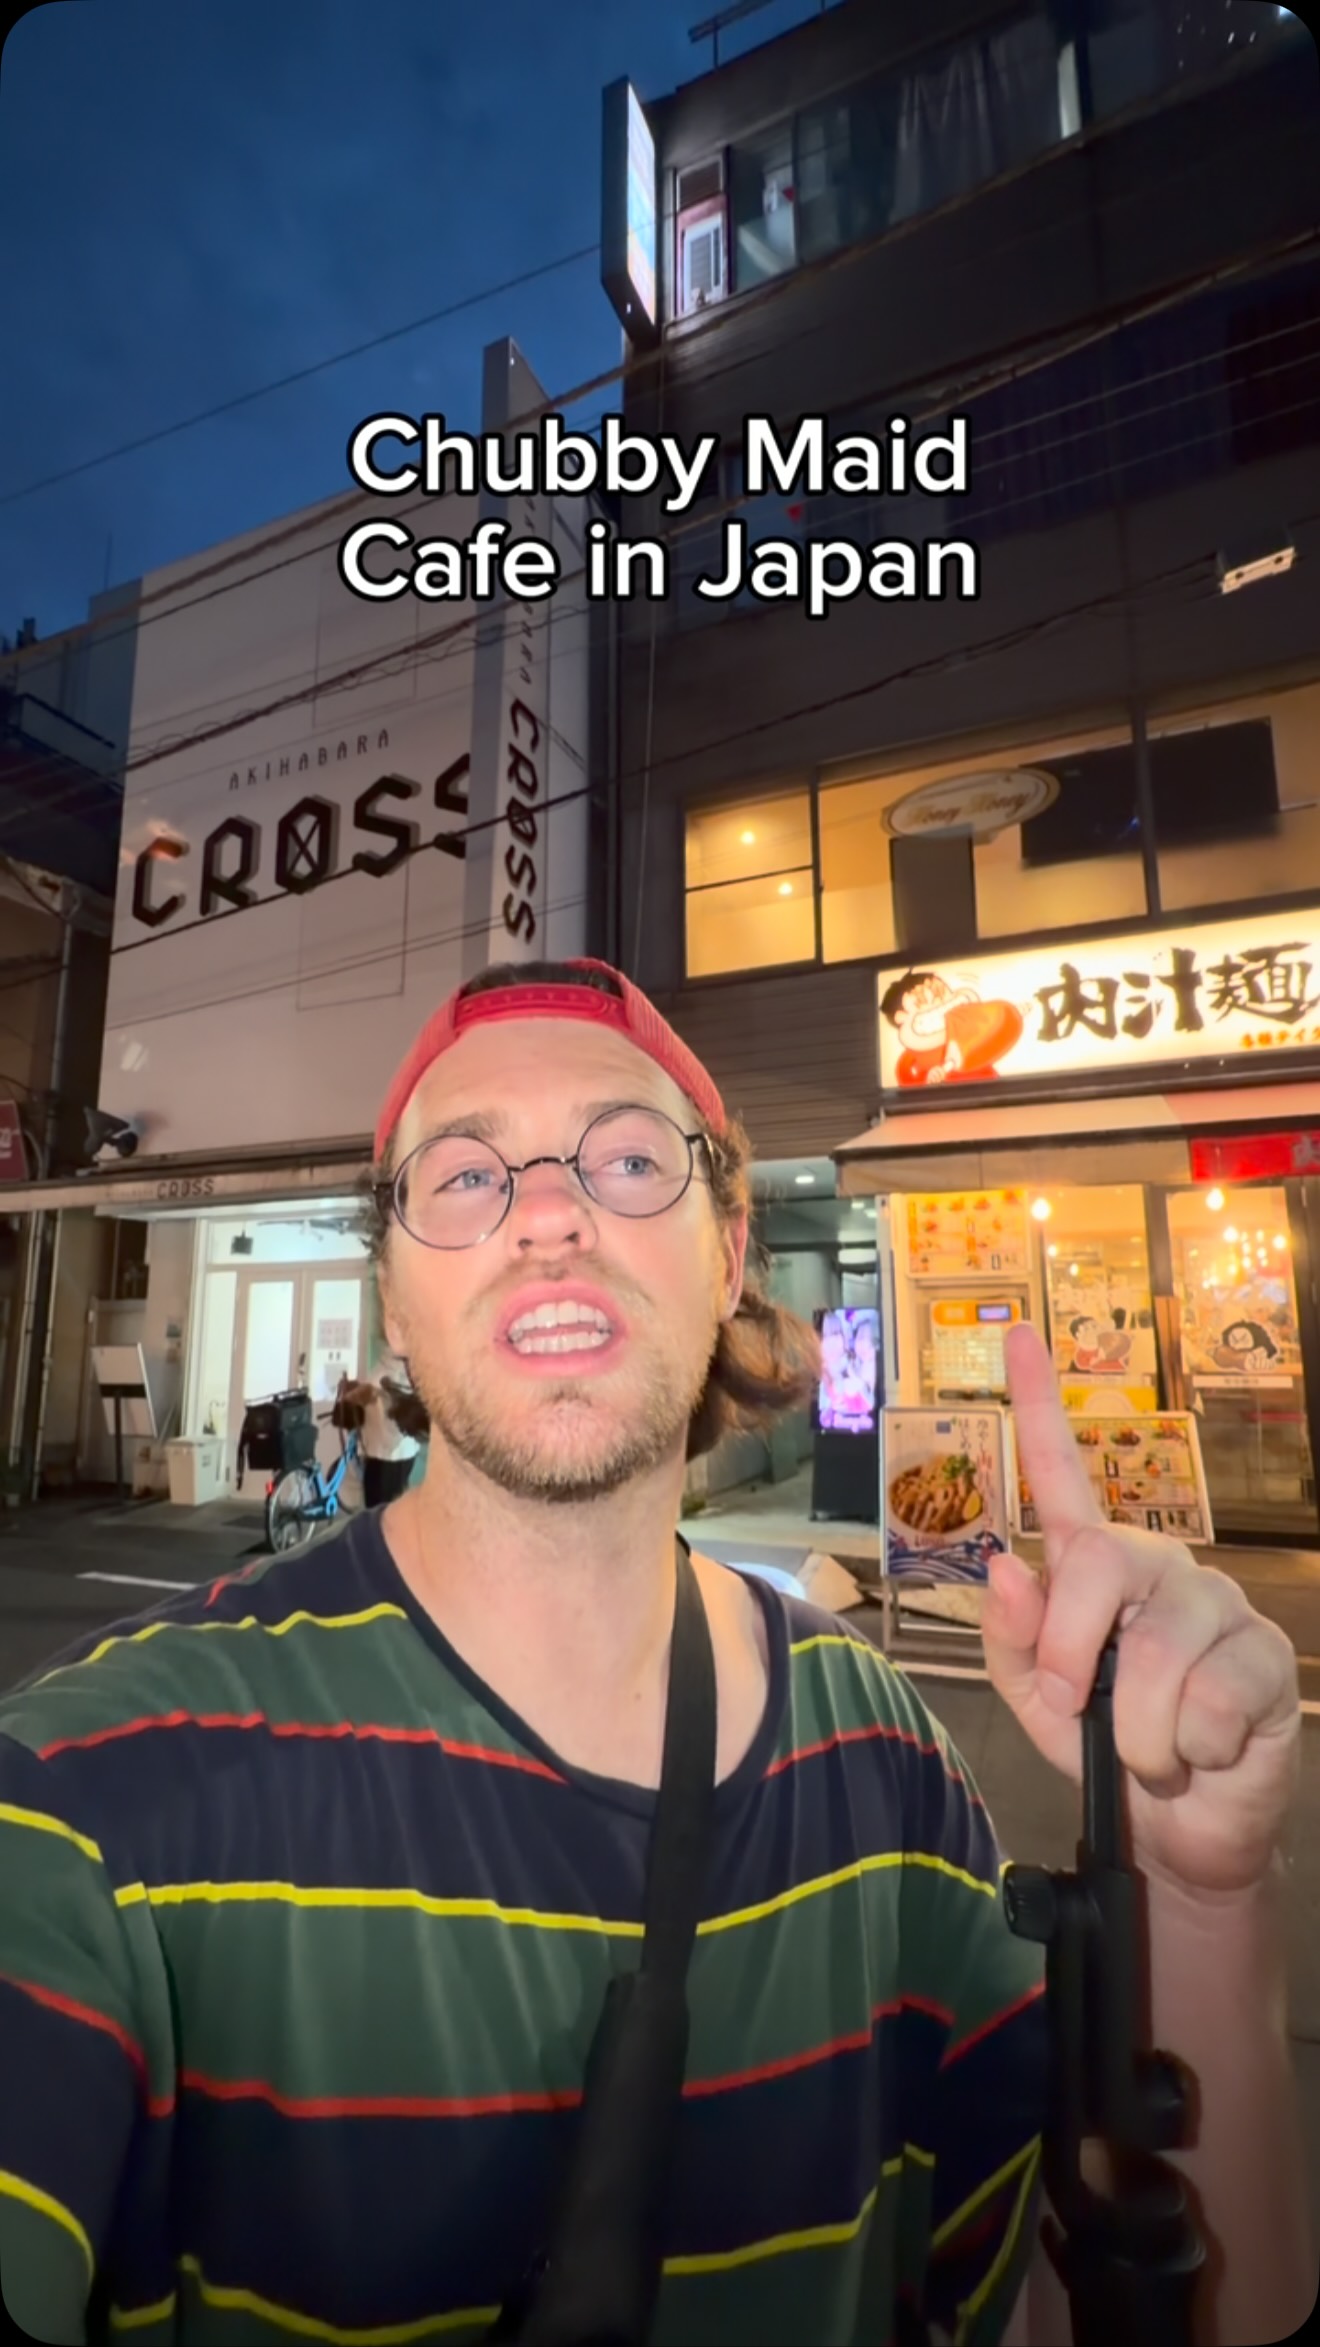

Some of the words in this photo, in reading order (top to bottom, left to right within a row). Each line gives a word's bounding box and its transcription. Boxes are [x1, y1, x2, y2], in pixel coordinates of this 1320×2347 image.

[228, 728, 390, 791] AKIHABARA
[503, 697, 541, 945] CROSS
[1033, 941, 1320, 1042] 肉汁麺
[156, 1177, 215, 1200] CROSS
